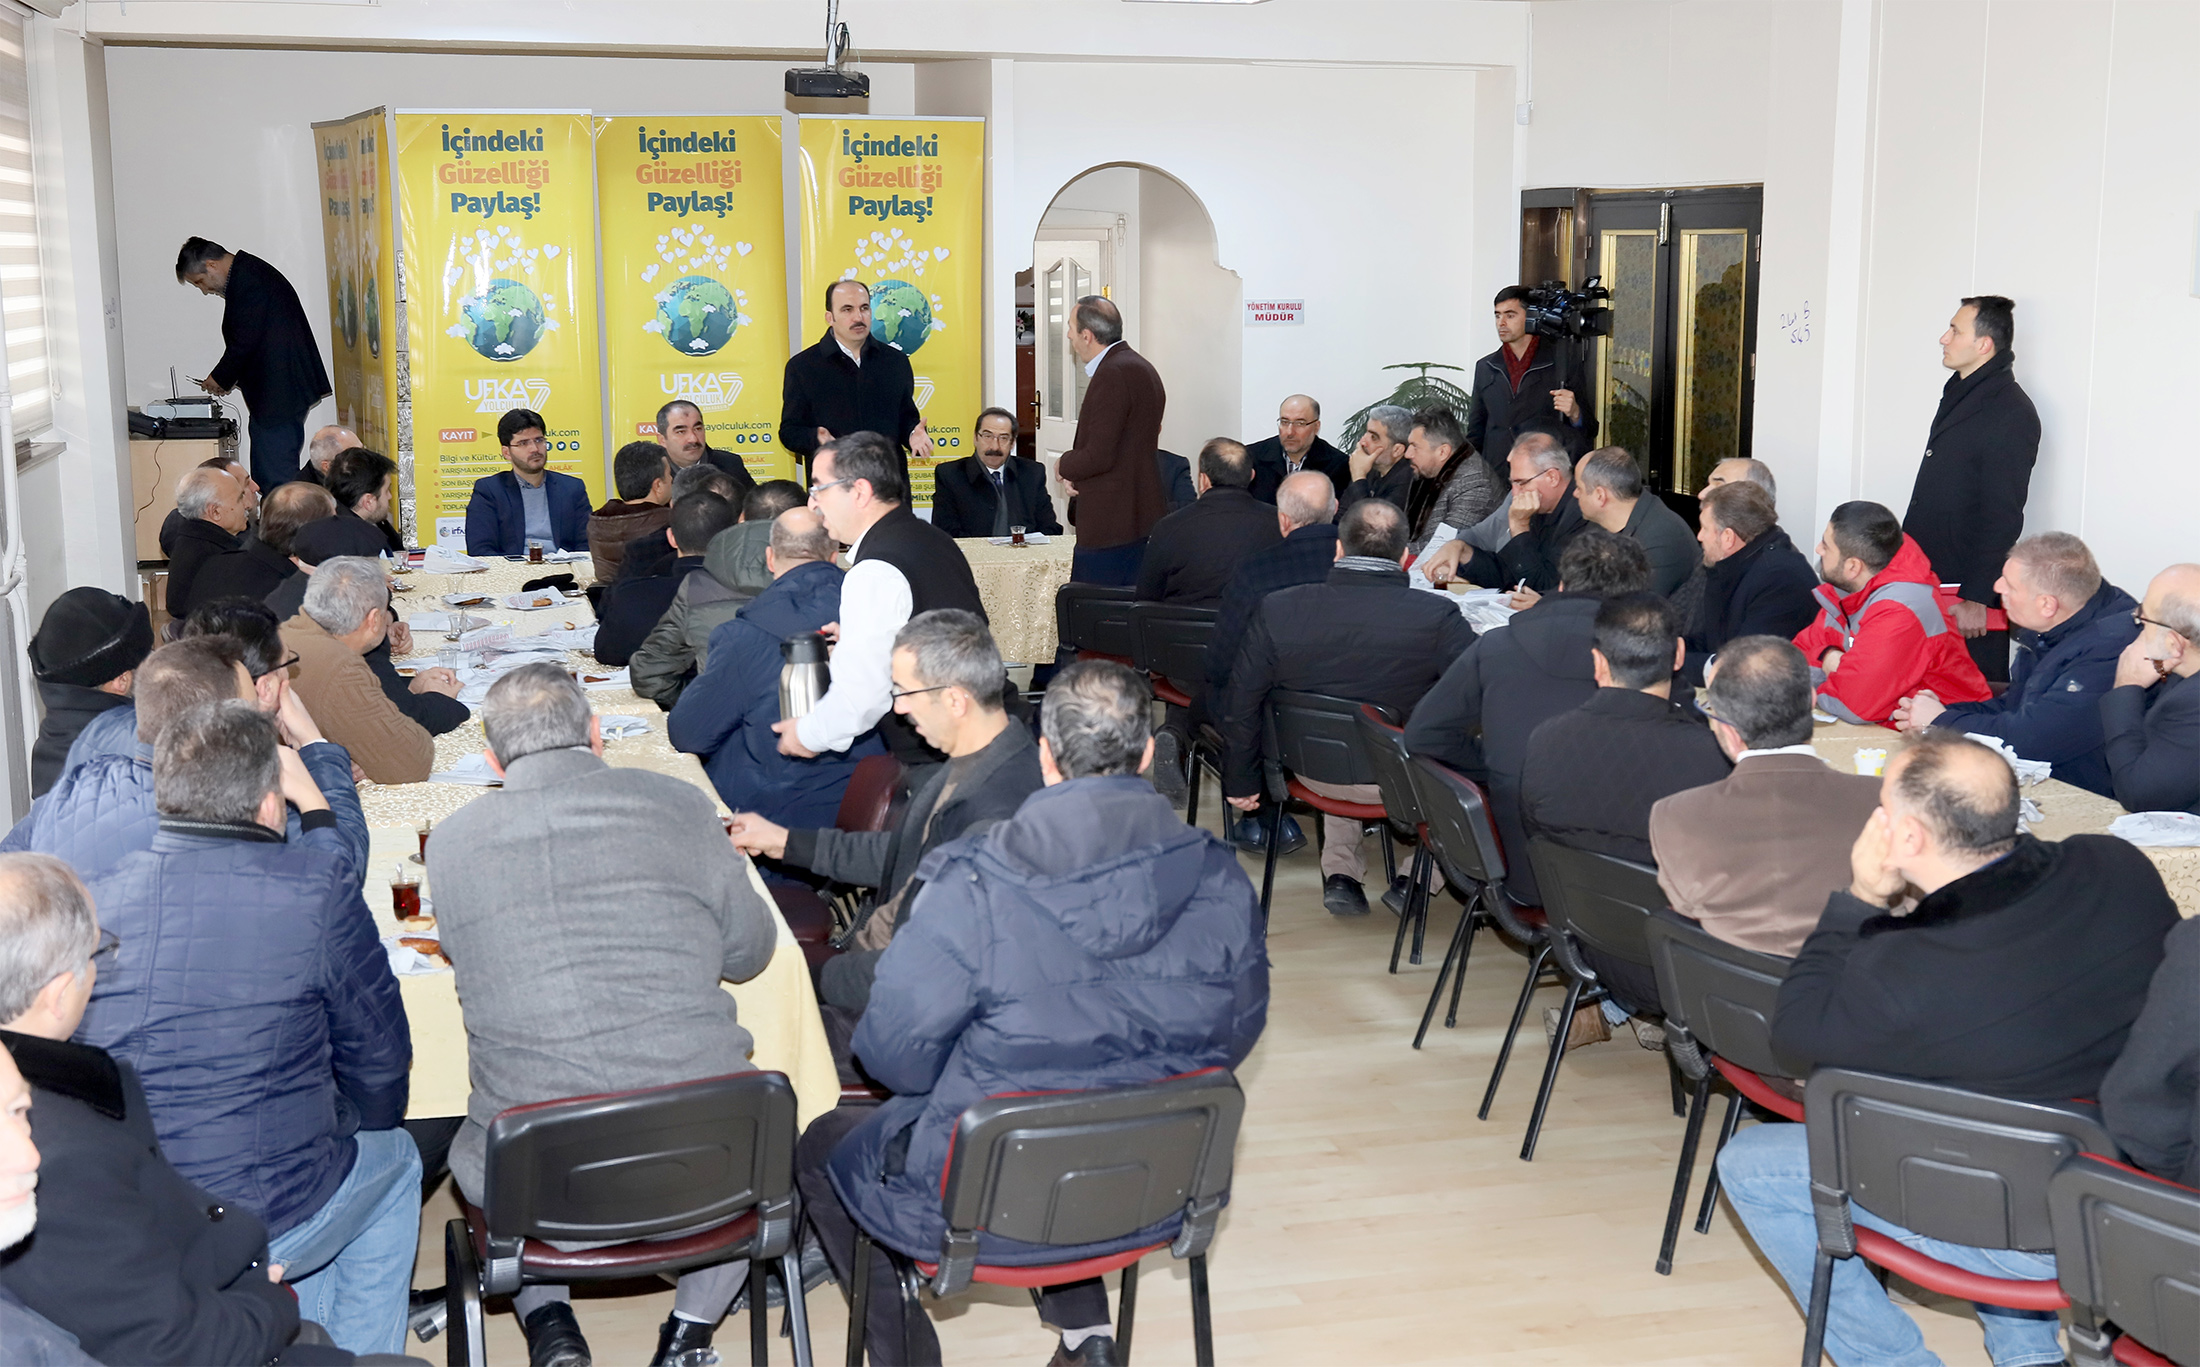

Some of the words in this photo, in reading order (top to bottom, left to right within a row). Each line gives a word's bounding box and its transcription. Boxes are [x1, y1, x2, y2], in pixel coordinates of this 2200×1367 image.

[441, 123, 544, 159] İçindeki
[638, 126, 737, 160] İçindeki
[842, 128, 939, 163] İçindeki
[438, 159, 550, 190] Güzelliği
[635, 159, 742, 189] Güzelliği
[838, 164, 943, 194] Güzelliği
[450, 190, 541, 220] Paylaş!
[647, 190, 734, 218] Paylaş!
[848, 194, 934, 223] Paylaş!
[1247, 302, 1276, 310] YÖNETİM
[1255, 312, 1294, 321] MÜDÜR
[464, 378, 528, 400] UFKA
[660, 372, 722, 394] UFKA
[484, 401, 527, 411] YOLCULUK
[442, 430, 474, 440] KAYIT
[639, 425, 658, 433] KAY
[440, 454, 458, 464] Bilgi
[472, 453, 497, 461] Kültür
[441, 467, 471, 475] YARIŞMA
[472, 466, 500, 474] KONUSU
